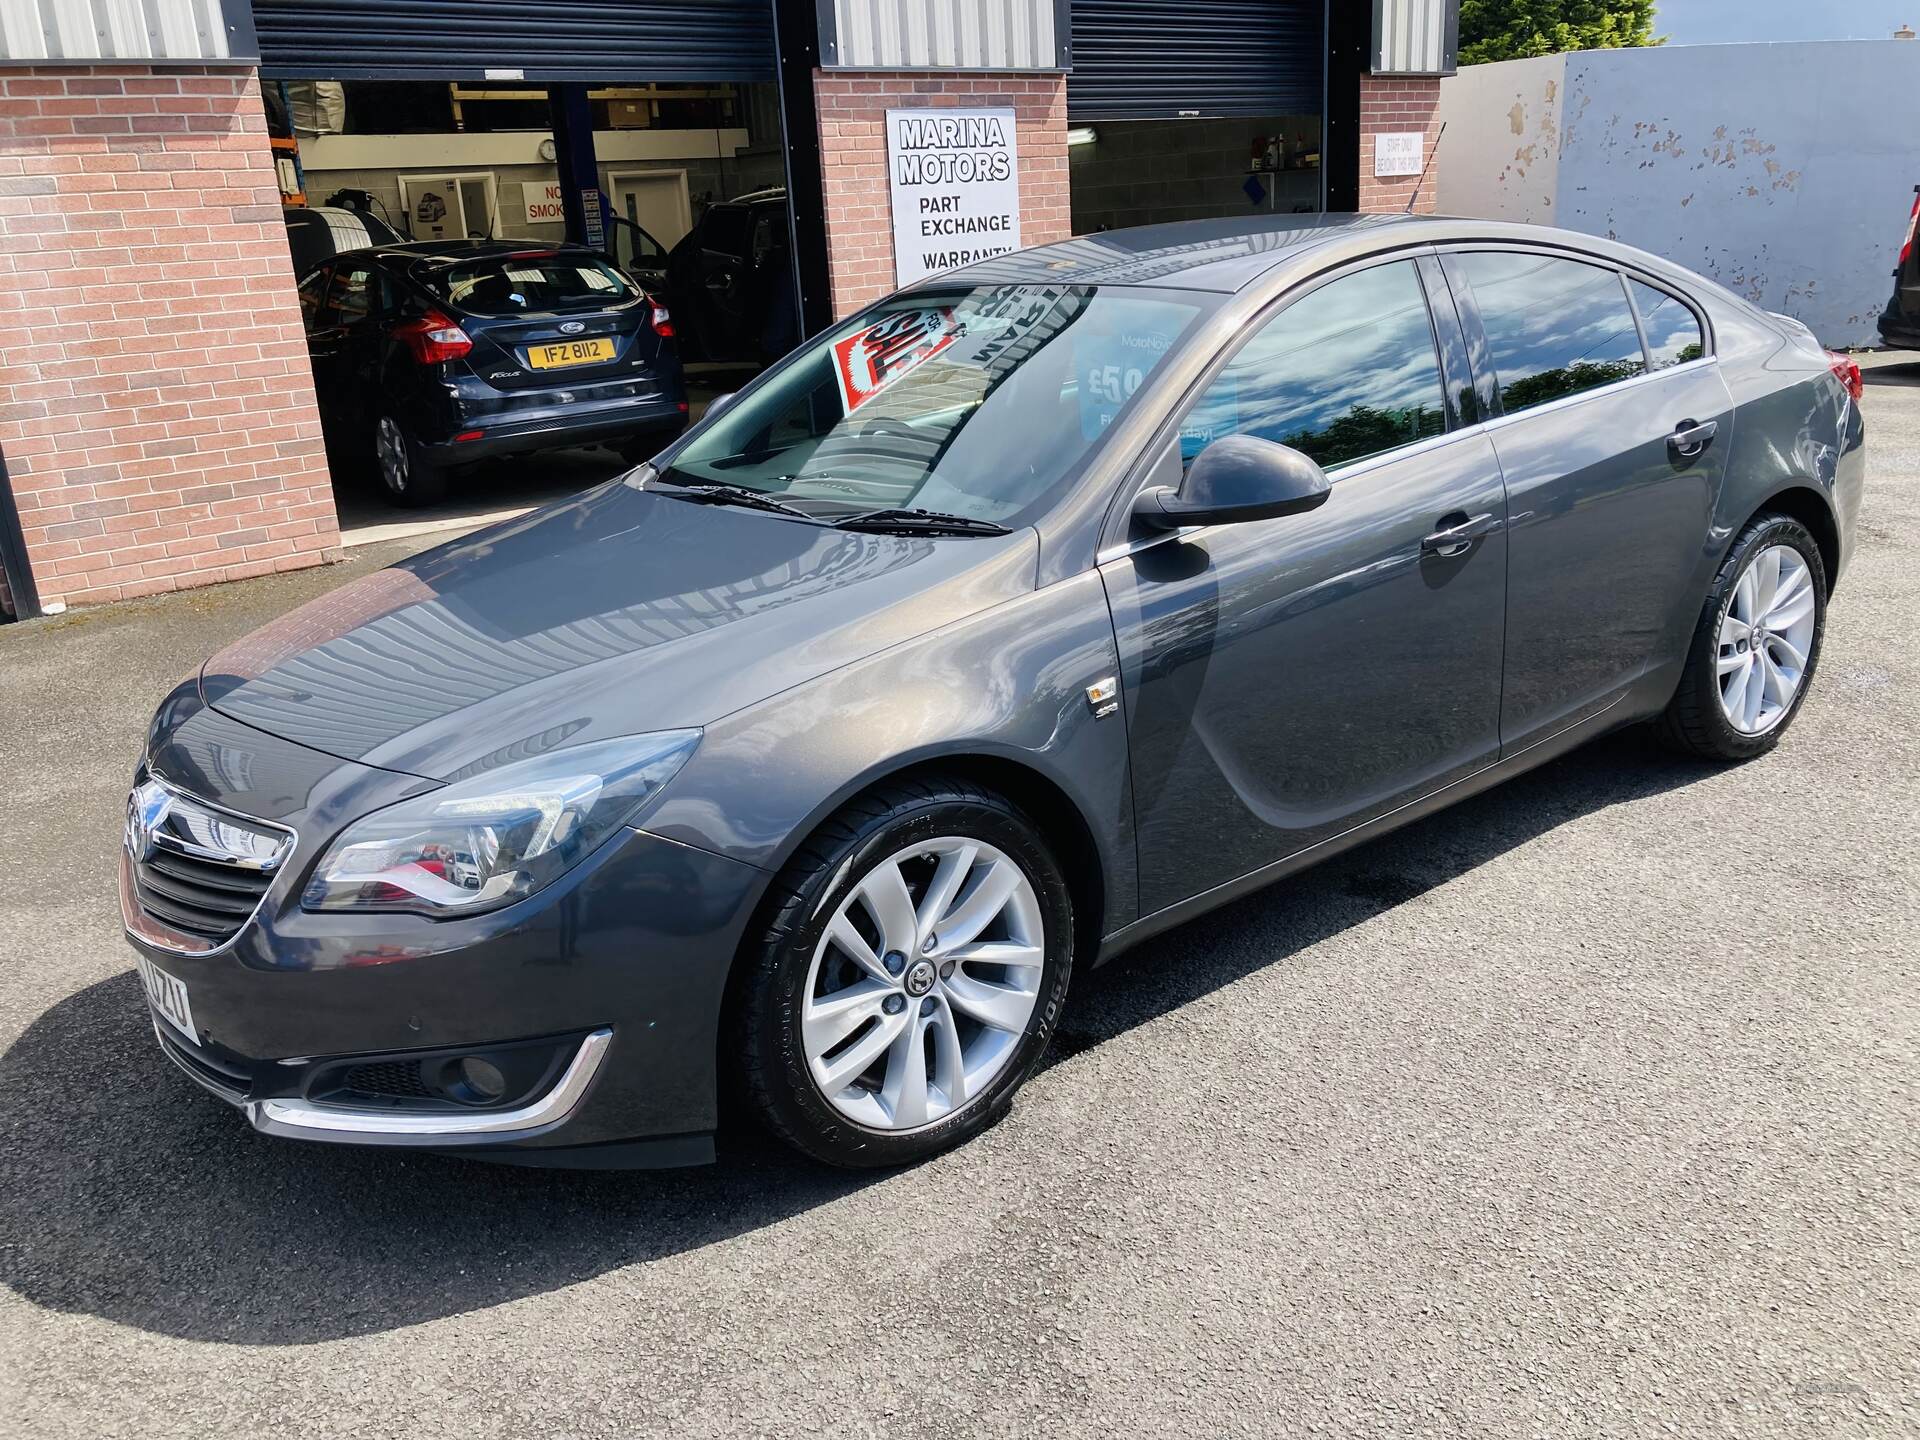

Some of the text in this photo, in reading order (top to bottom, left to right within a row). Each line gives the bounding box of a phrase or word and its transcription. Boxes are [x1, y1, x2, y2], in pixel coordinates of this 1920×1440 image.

[899, 117, 1006, 150] MARINA
[898, 151, 1011, 185] MOTORS
[919, 195, 961, 214] PART
[921, 214, 1011, 237] EXCHANGE
[543, 341, 601, 363] IFZ 8112
